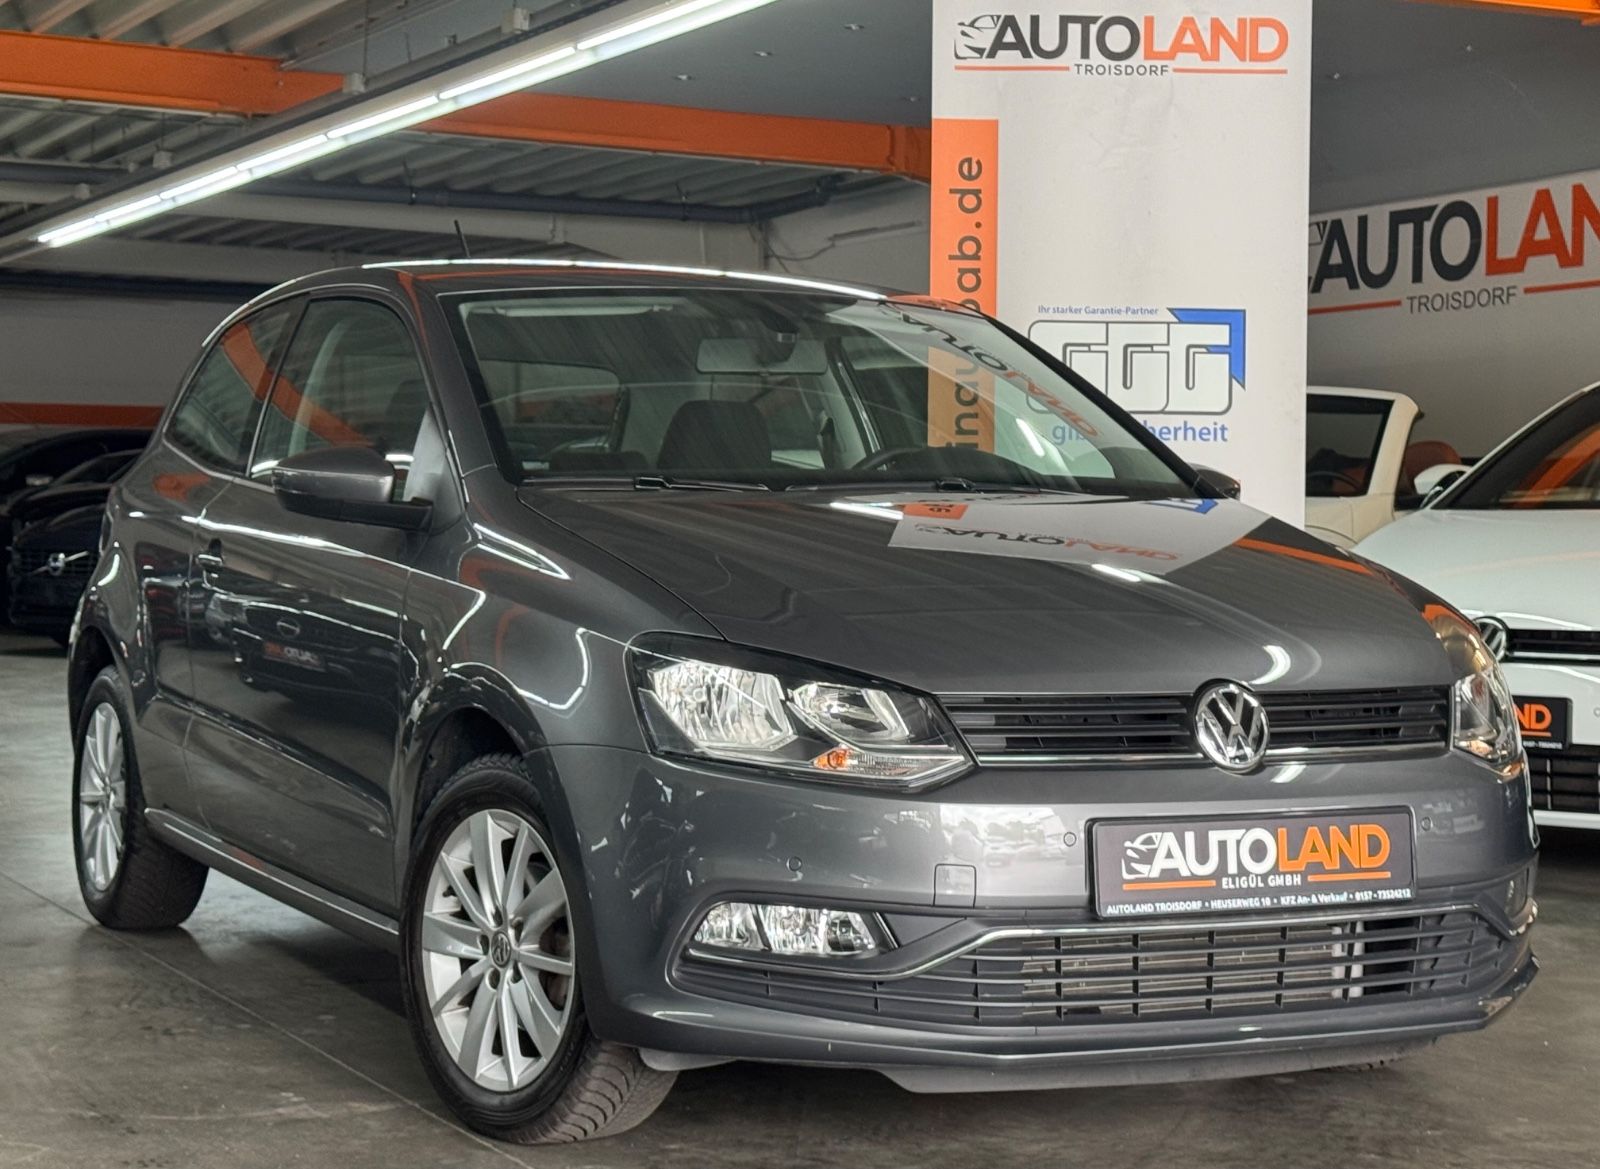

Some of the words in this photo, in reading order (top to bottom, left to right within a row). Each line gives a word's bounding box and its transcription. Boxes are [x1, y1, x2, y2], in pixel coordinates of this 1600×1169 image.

[985, 14, 1289, 62] AUTOLAND
[1074, 64, 1169, 76] TROISDORF
[1038, 305, 1051, 314] Ihr
[1052, 305, 1083, 315] starker
[1084, 306, 1159, 316] Garantie-Partner
[1406, 286, 1517, 314] TROISDORF
[1149, 824, 1391, 878] AUTOLAND
[1268, 874, 1301, 888] GMBH
[1106, 902, 1154, 914] AUTOLAND
[1155, 900, 1202, 912] TROISDORF
[1210, 897, 1260, 910] HEUSERWEG
[1280, 894, 1297, 906] KFZ
[1318, 891, 1348, 904] Verkauf
